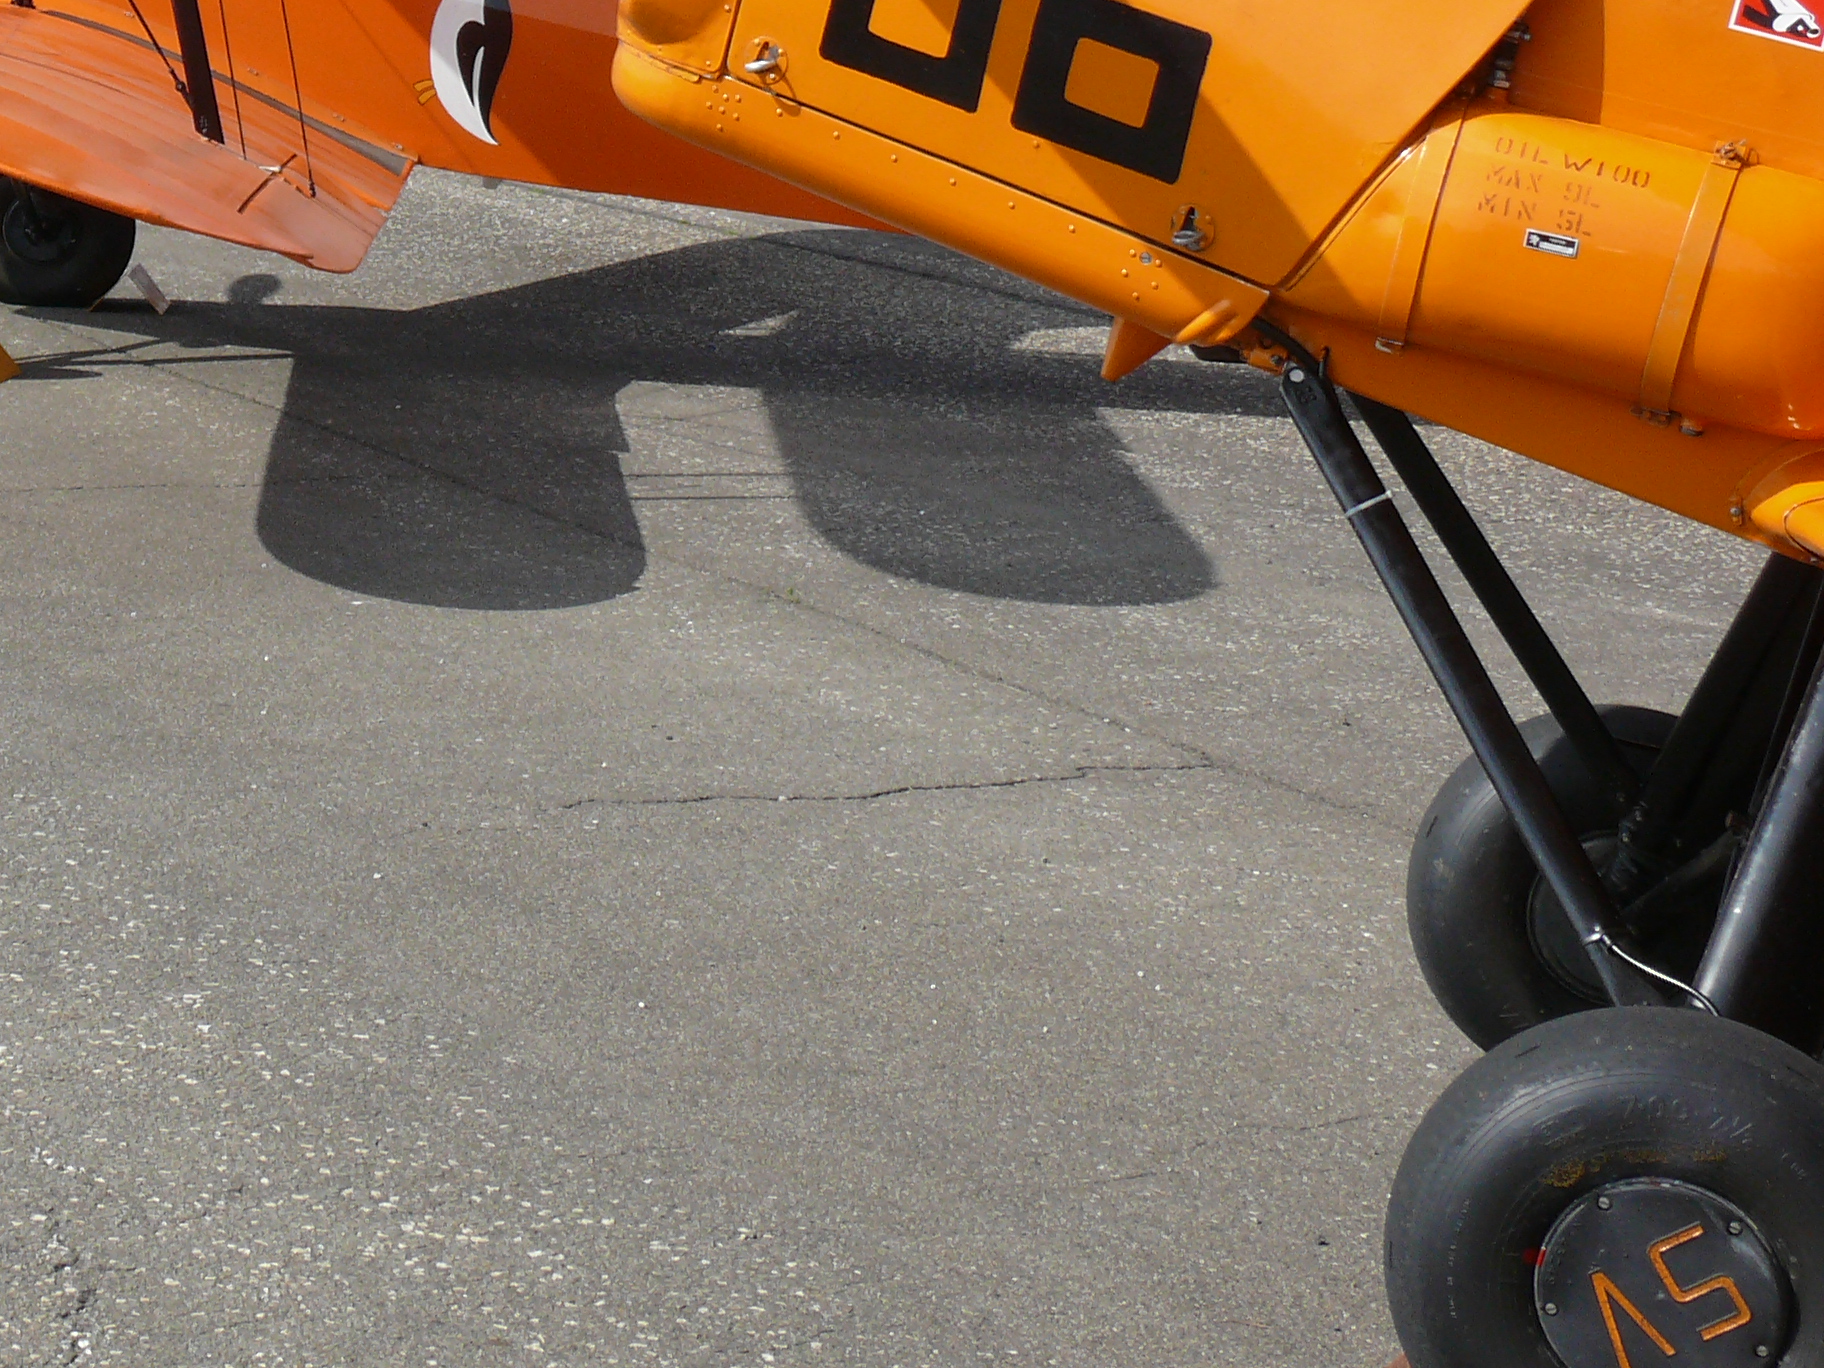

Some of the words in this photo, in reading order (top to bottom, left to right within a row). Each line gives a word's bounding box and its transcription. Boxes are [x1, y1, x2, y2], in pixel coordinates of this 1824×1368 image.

[1495, 136, 1549, 165] OIL
[1564, 153, 1650, 188] W100
[1486, 165, 1543, 193] MAX
[1478, 193, 1538, 221] MIN
